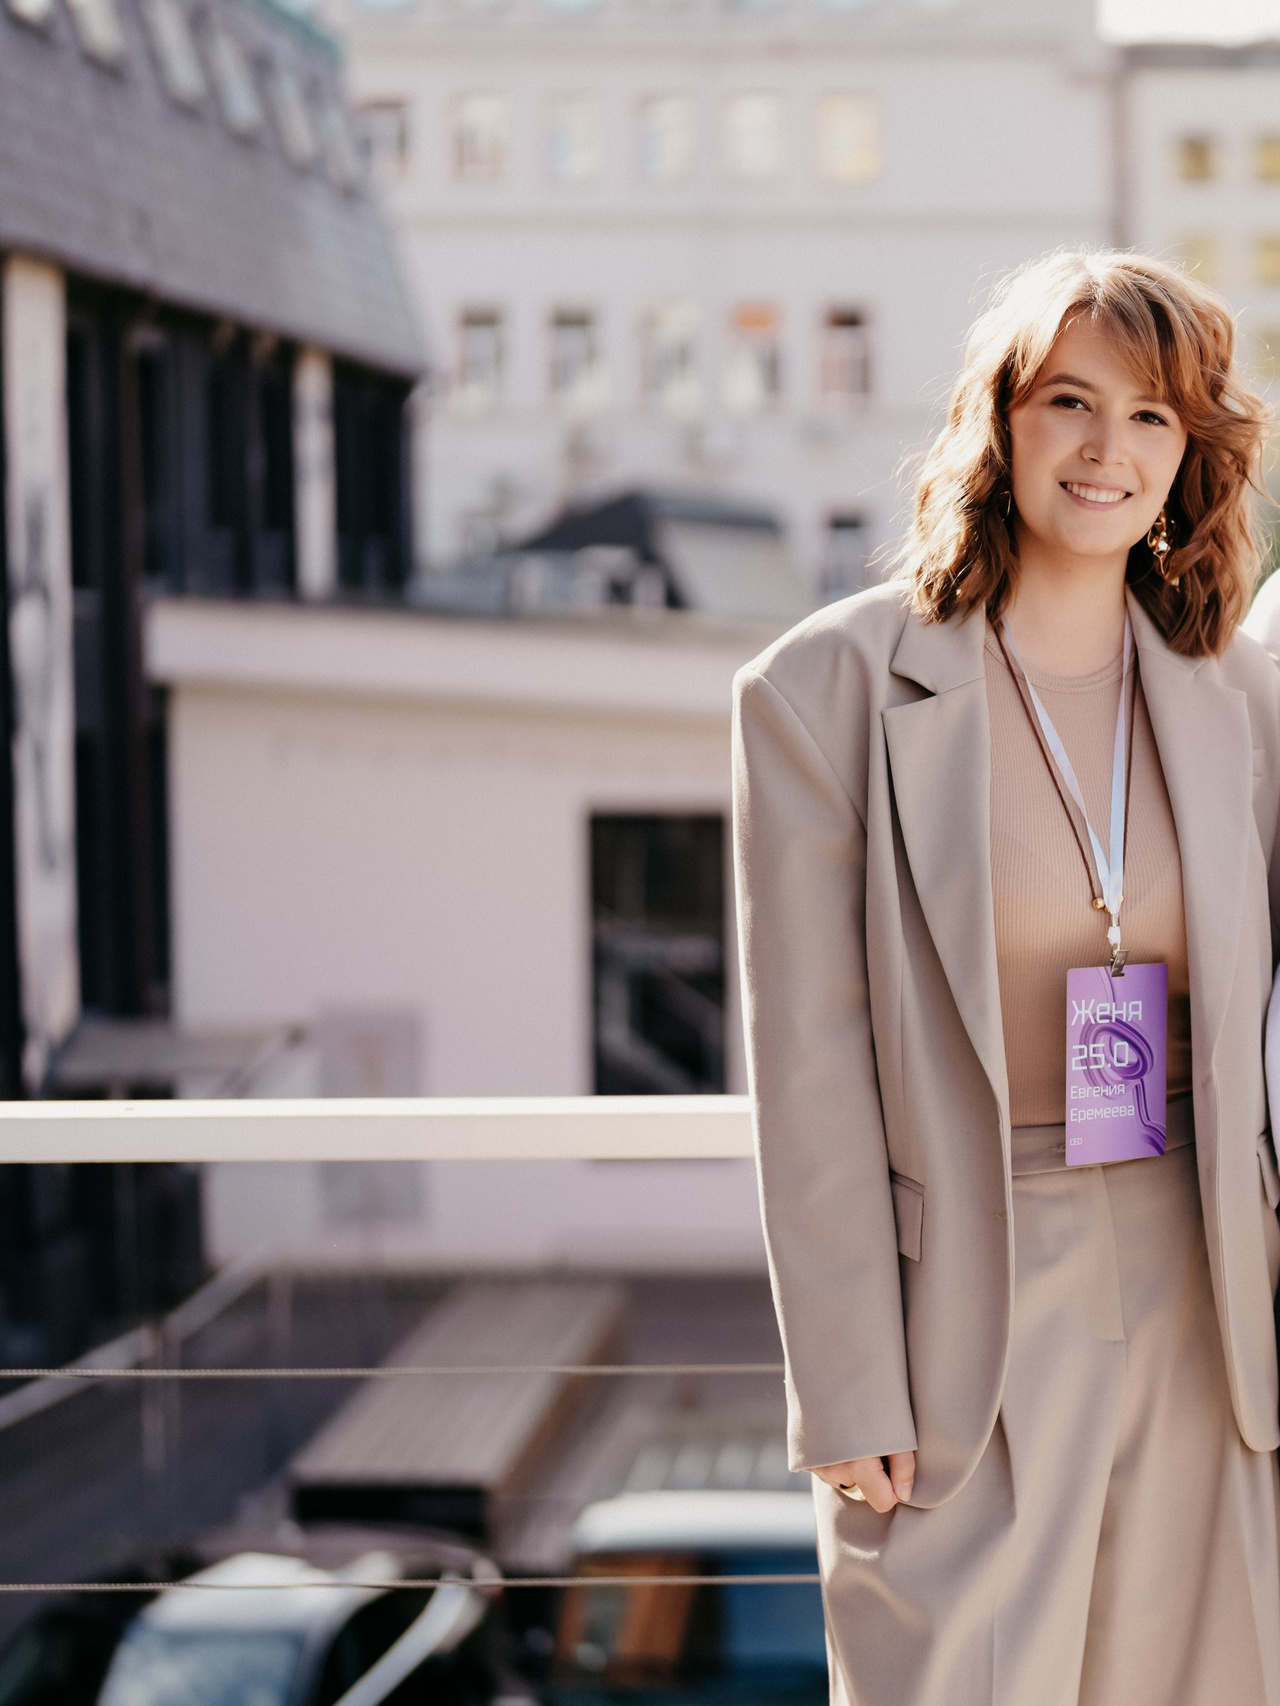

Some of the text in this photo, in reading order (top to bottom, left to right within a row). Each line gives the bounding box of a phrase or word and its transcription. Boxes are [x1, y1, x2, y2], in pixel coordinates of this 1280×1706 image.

[1071, 999, 1142, 1025] Женя
[1071, 1041, 1128, 1071] 25.0
[1070, 1084, 1125, 1100] Евгения
[1070, 1104, 1135, 1123] Еремеева
[1070, 1137, 1083, 1146] CEO
